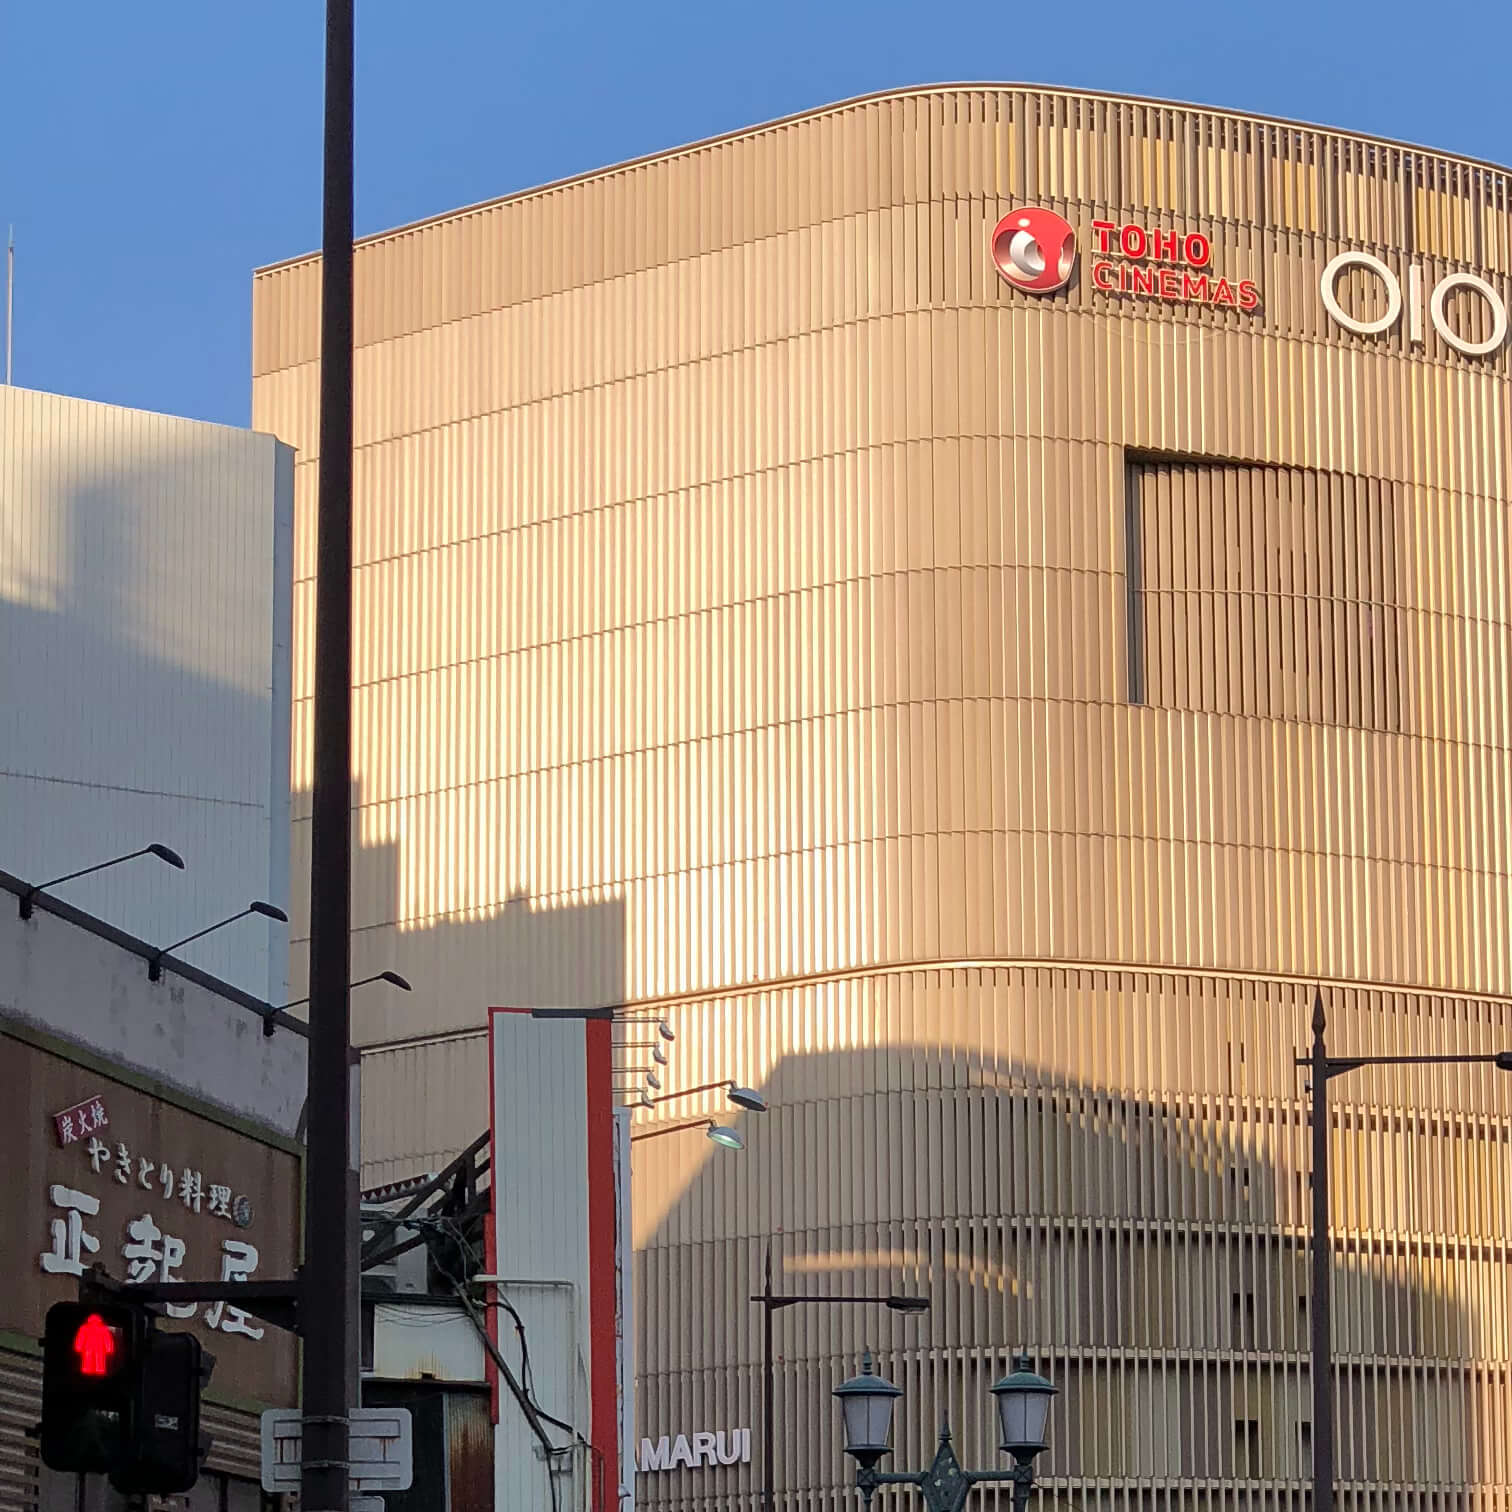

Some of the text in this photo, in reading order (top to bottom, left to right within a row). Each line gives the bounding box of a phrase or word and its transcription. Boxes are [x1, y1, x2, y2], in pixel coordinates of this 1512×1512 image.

[1092, 219, 1213, 268] TOHO
[1091, 261, 1260, 311] CINEMAS
[61, 1100, 109, 1145] 炭火焼
[88, 1136, 232, 1220] やきとり料理
[641, 1428, 751, 1472] MARUI
